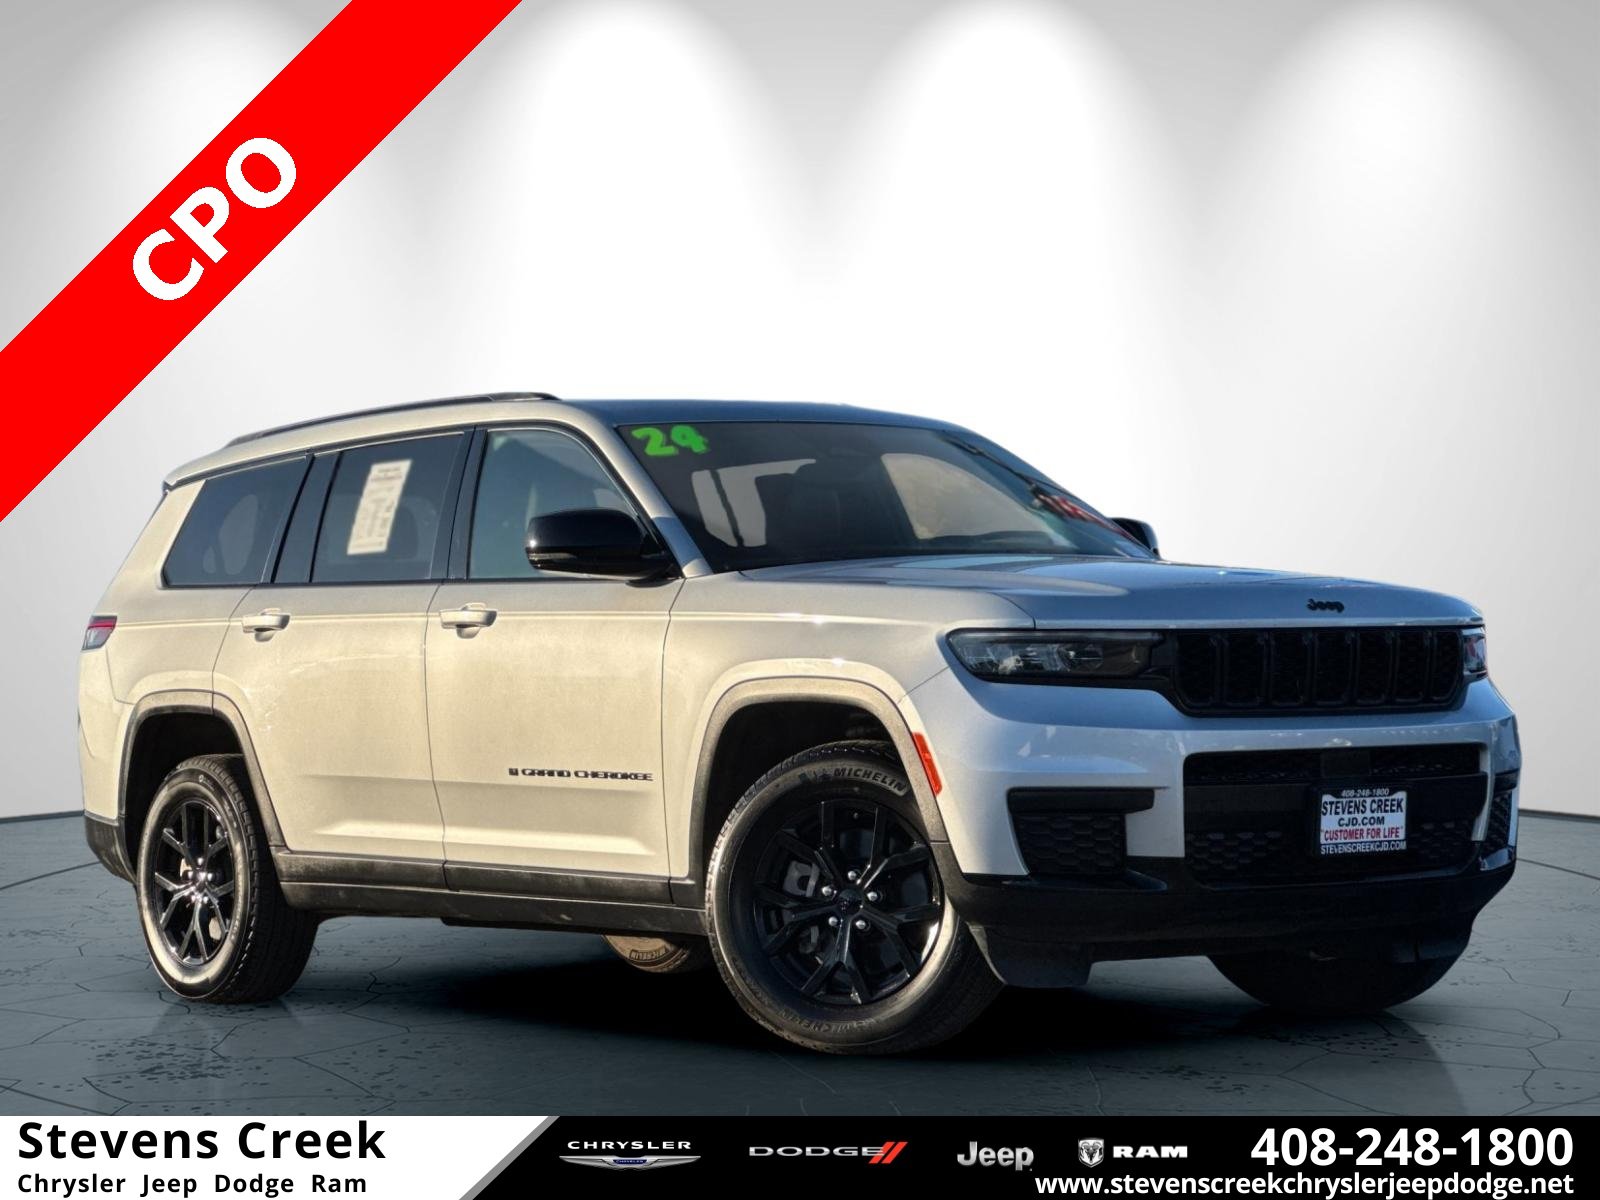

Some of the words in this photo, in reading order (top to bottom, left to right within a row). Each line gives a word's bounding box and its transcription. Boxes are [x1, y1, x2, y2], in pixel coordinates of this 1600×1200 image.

[521, 768, 571, 778] GRAND
[574, 770, 653, 781] CHEROKEE
[833, 767, 907, 791] MICHELIN
[1321, 800, 1367, 816] STEVENS
[1369, 798, 1404, 814] CREEK
[1338, 816, 1385, 828] CJD.COM
[1366, 827, 1382, 840] FOR
[1320, 841, 1407, 855] STEVENSCREEKCJD.COM
